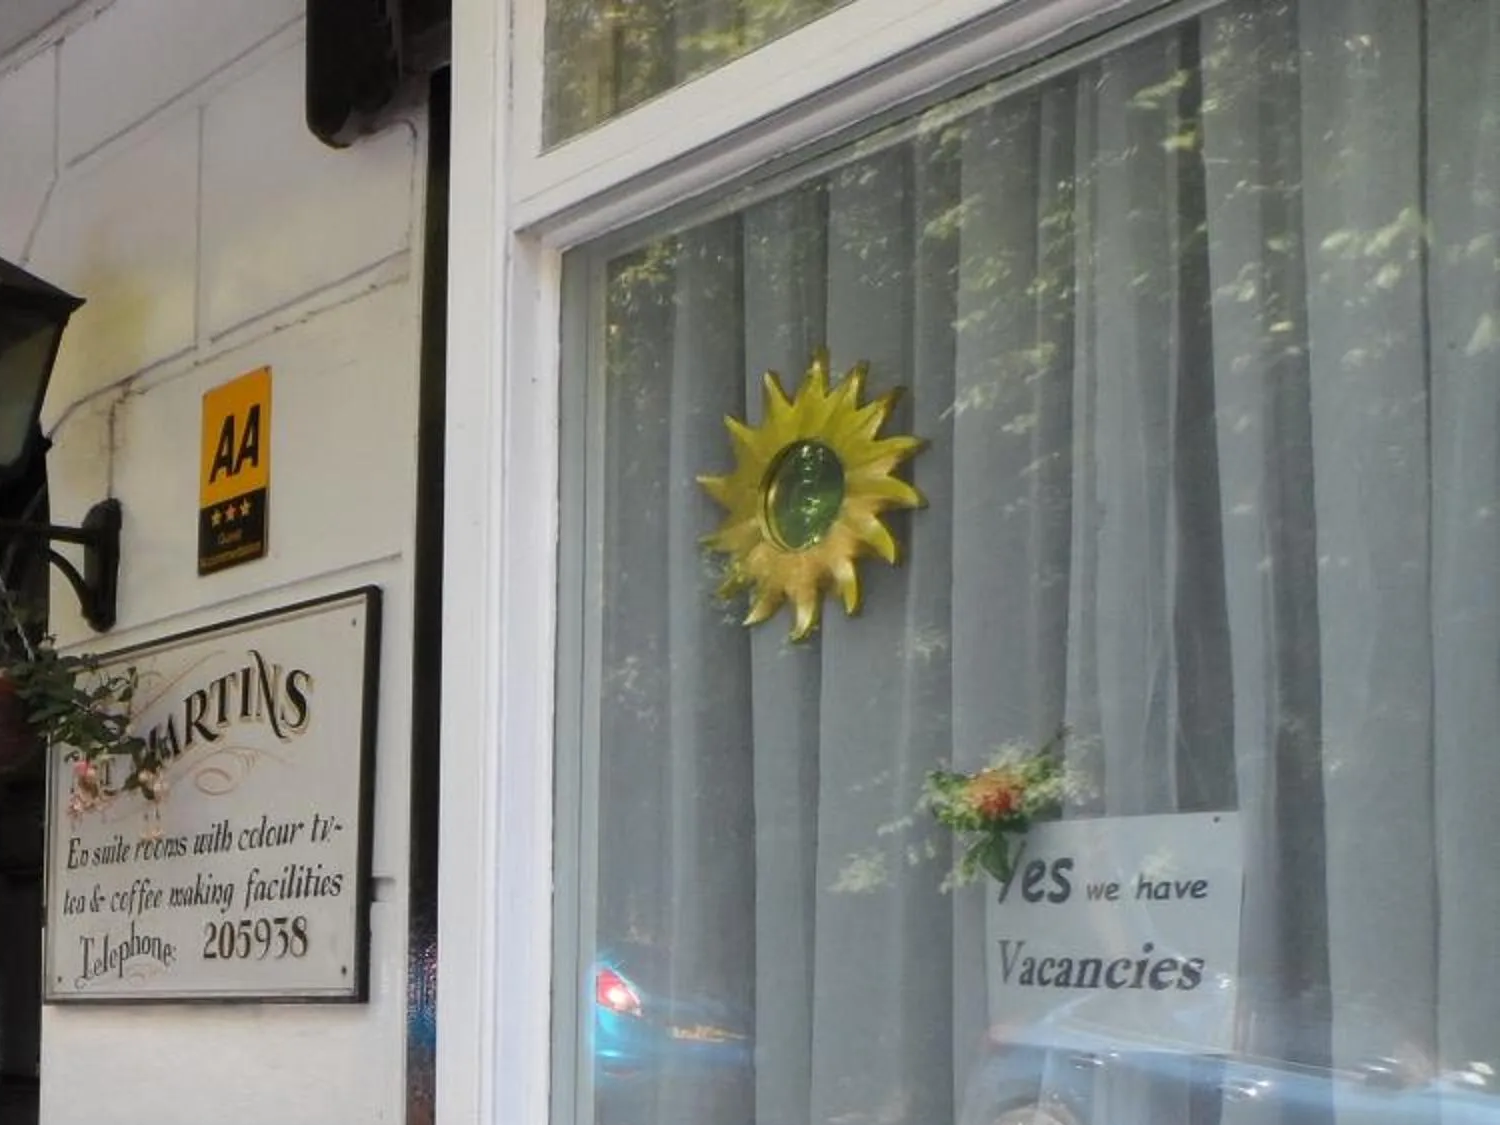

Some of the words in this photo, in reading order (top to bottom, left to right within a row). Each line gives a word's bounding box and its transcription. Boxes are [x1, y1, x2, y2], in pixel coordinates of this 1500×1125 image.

[209, 403, 261, 484] AA
[133, 836, 189, 862] rooms
[193, 819, 233, 855] with
[238, 815, 305, 851] colour
[63, 889, 86, 916] tea
[89, 884, 106, 914] &
[110, 877, 164, 916] coffee
[169, 872, 235, 914] making
[244, 863, 344, 911] facilities
[997, 840, 1074, 904] Yes
[1087, 882, 1120, 902] we
[1135, 873, 1209, 901] have
[202, 915, 308, 960] 205938
[998, 940, 1205, 991] Vacancies
